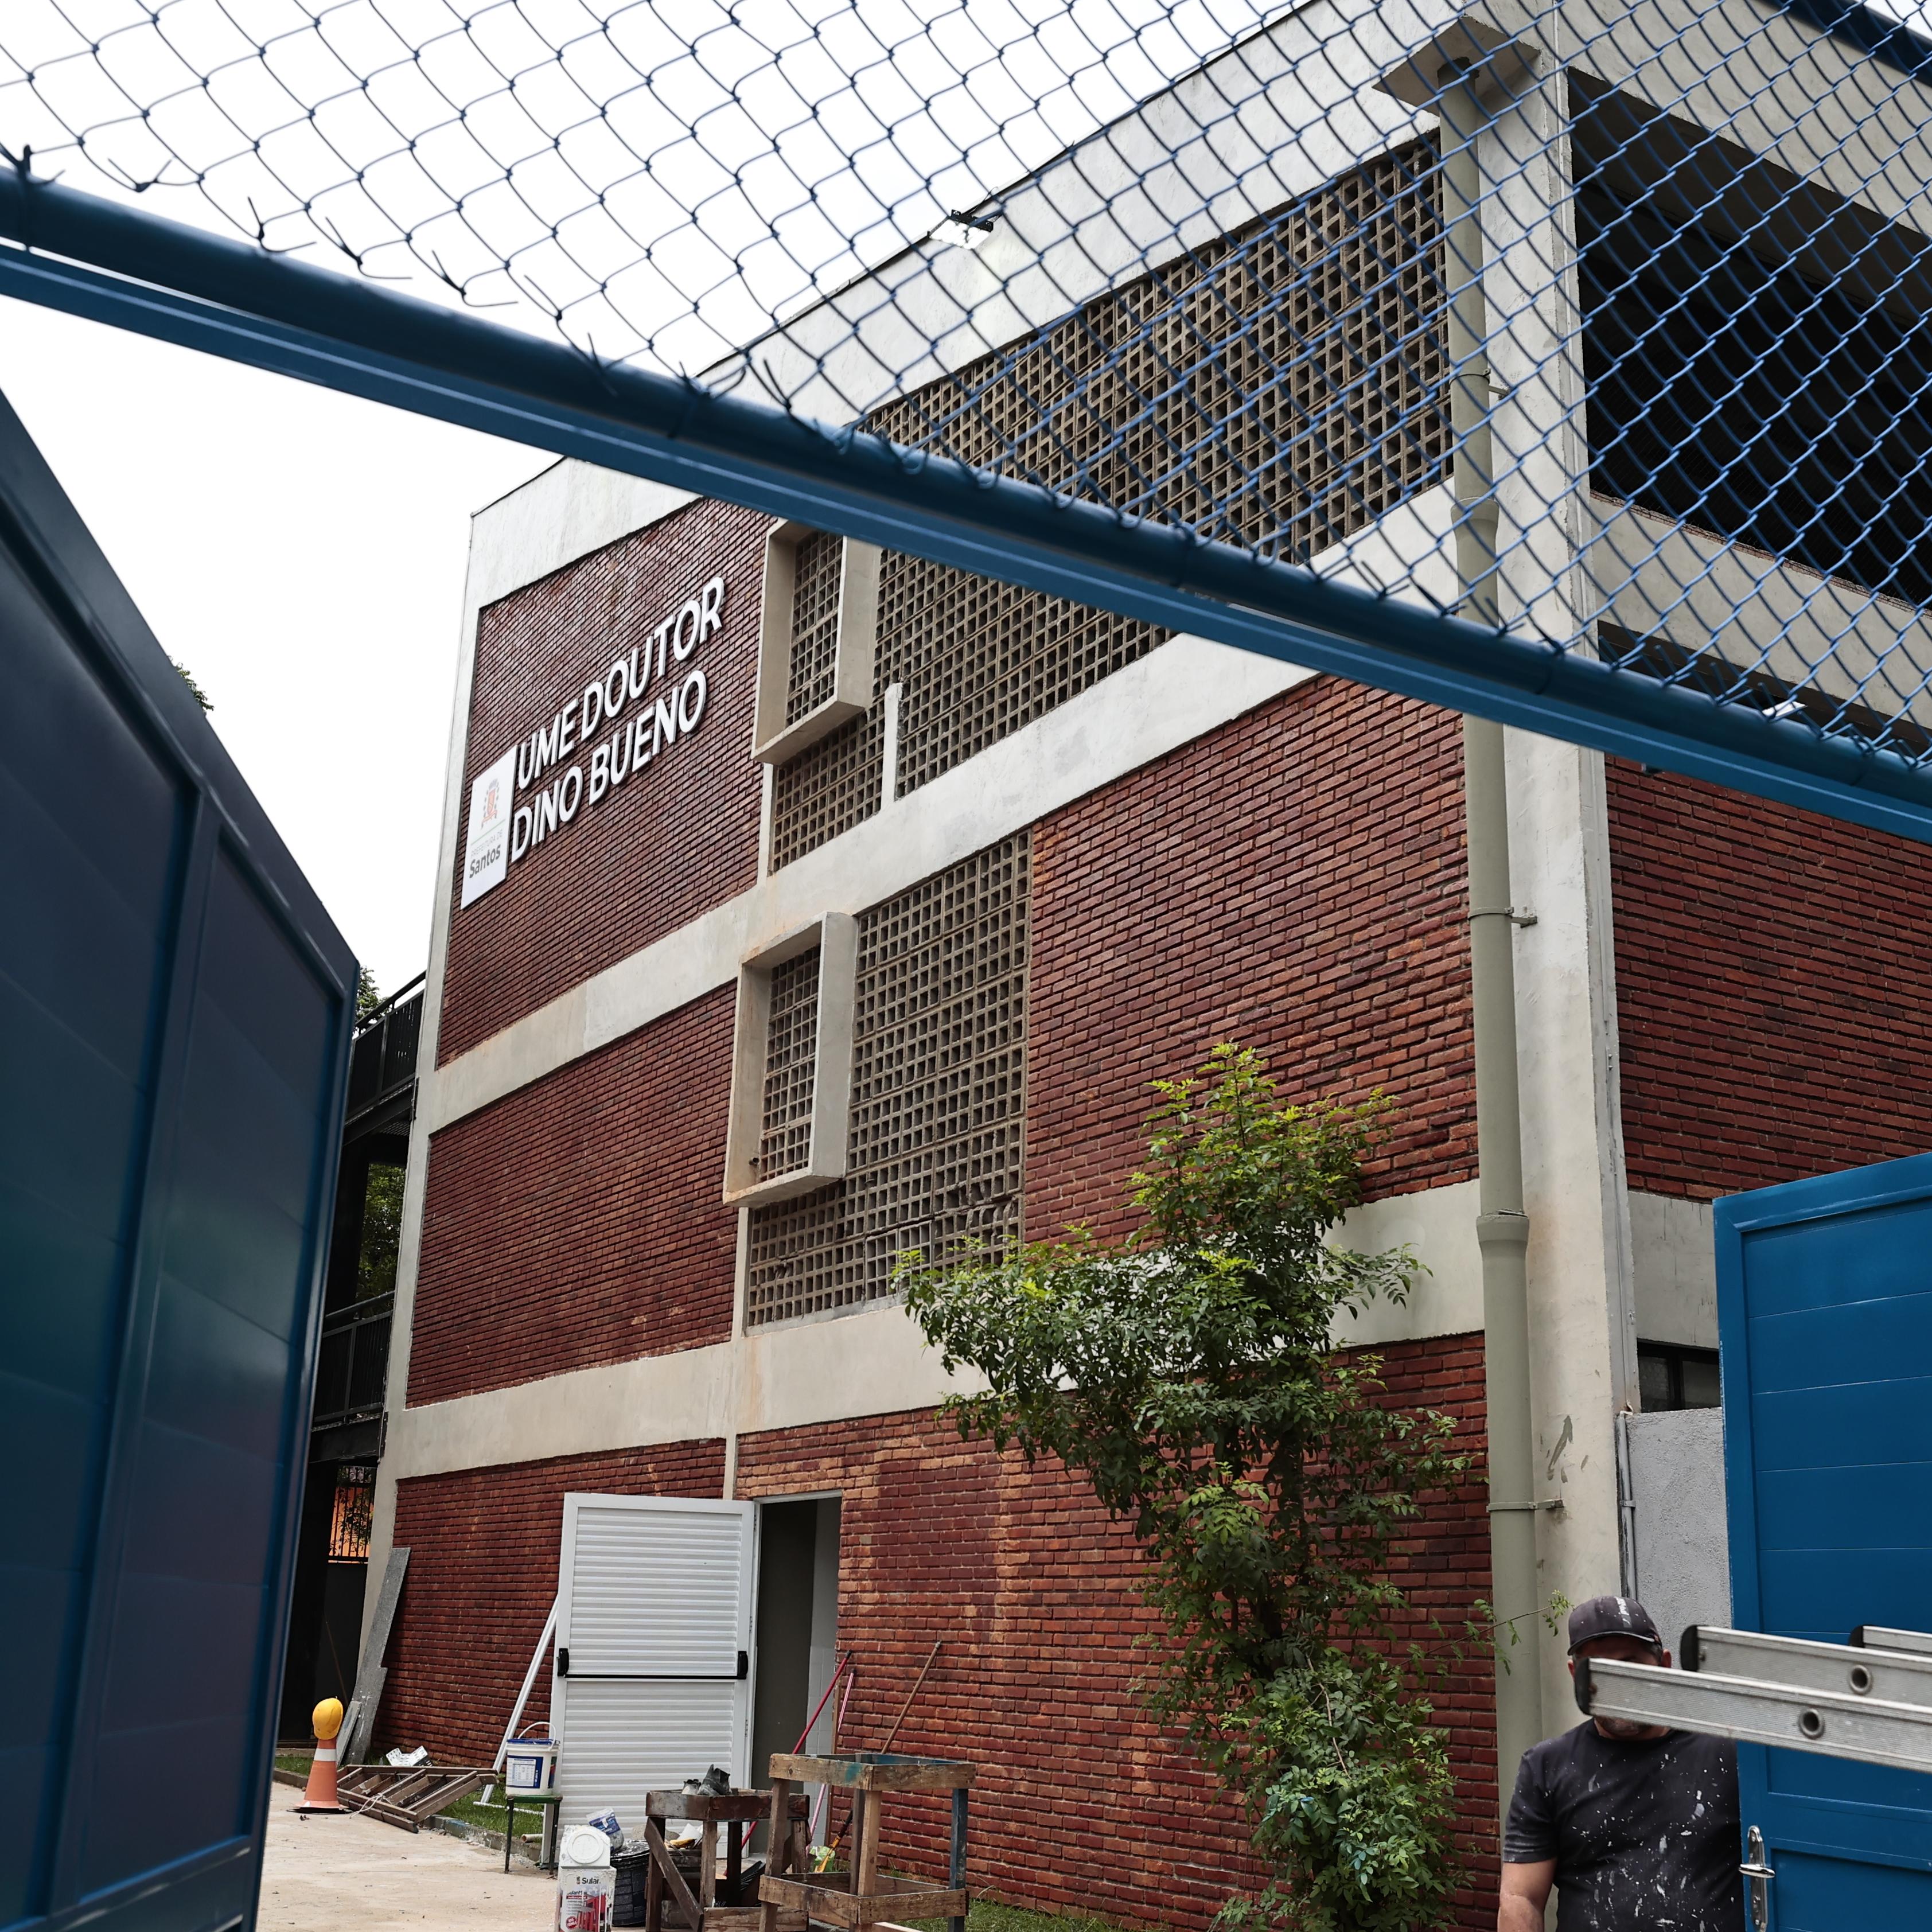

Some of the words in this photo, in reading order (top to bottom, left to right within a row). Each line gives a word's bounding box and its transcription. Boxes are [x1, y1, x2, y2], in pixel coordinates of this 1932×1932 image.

[511, 766, 583, 863] DINO
[589, 670, 707, 805] BUENO
[518, 698, 578, 790] UME
[581, 577, 726, 742] DOUTOR
[469, 844, 501, 879] Santos
